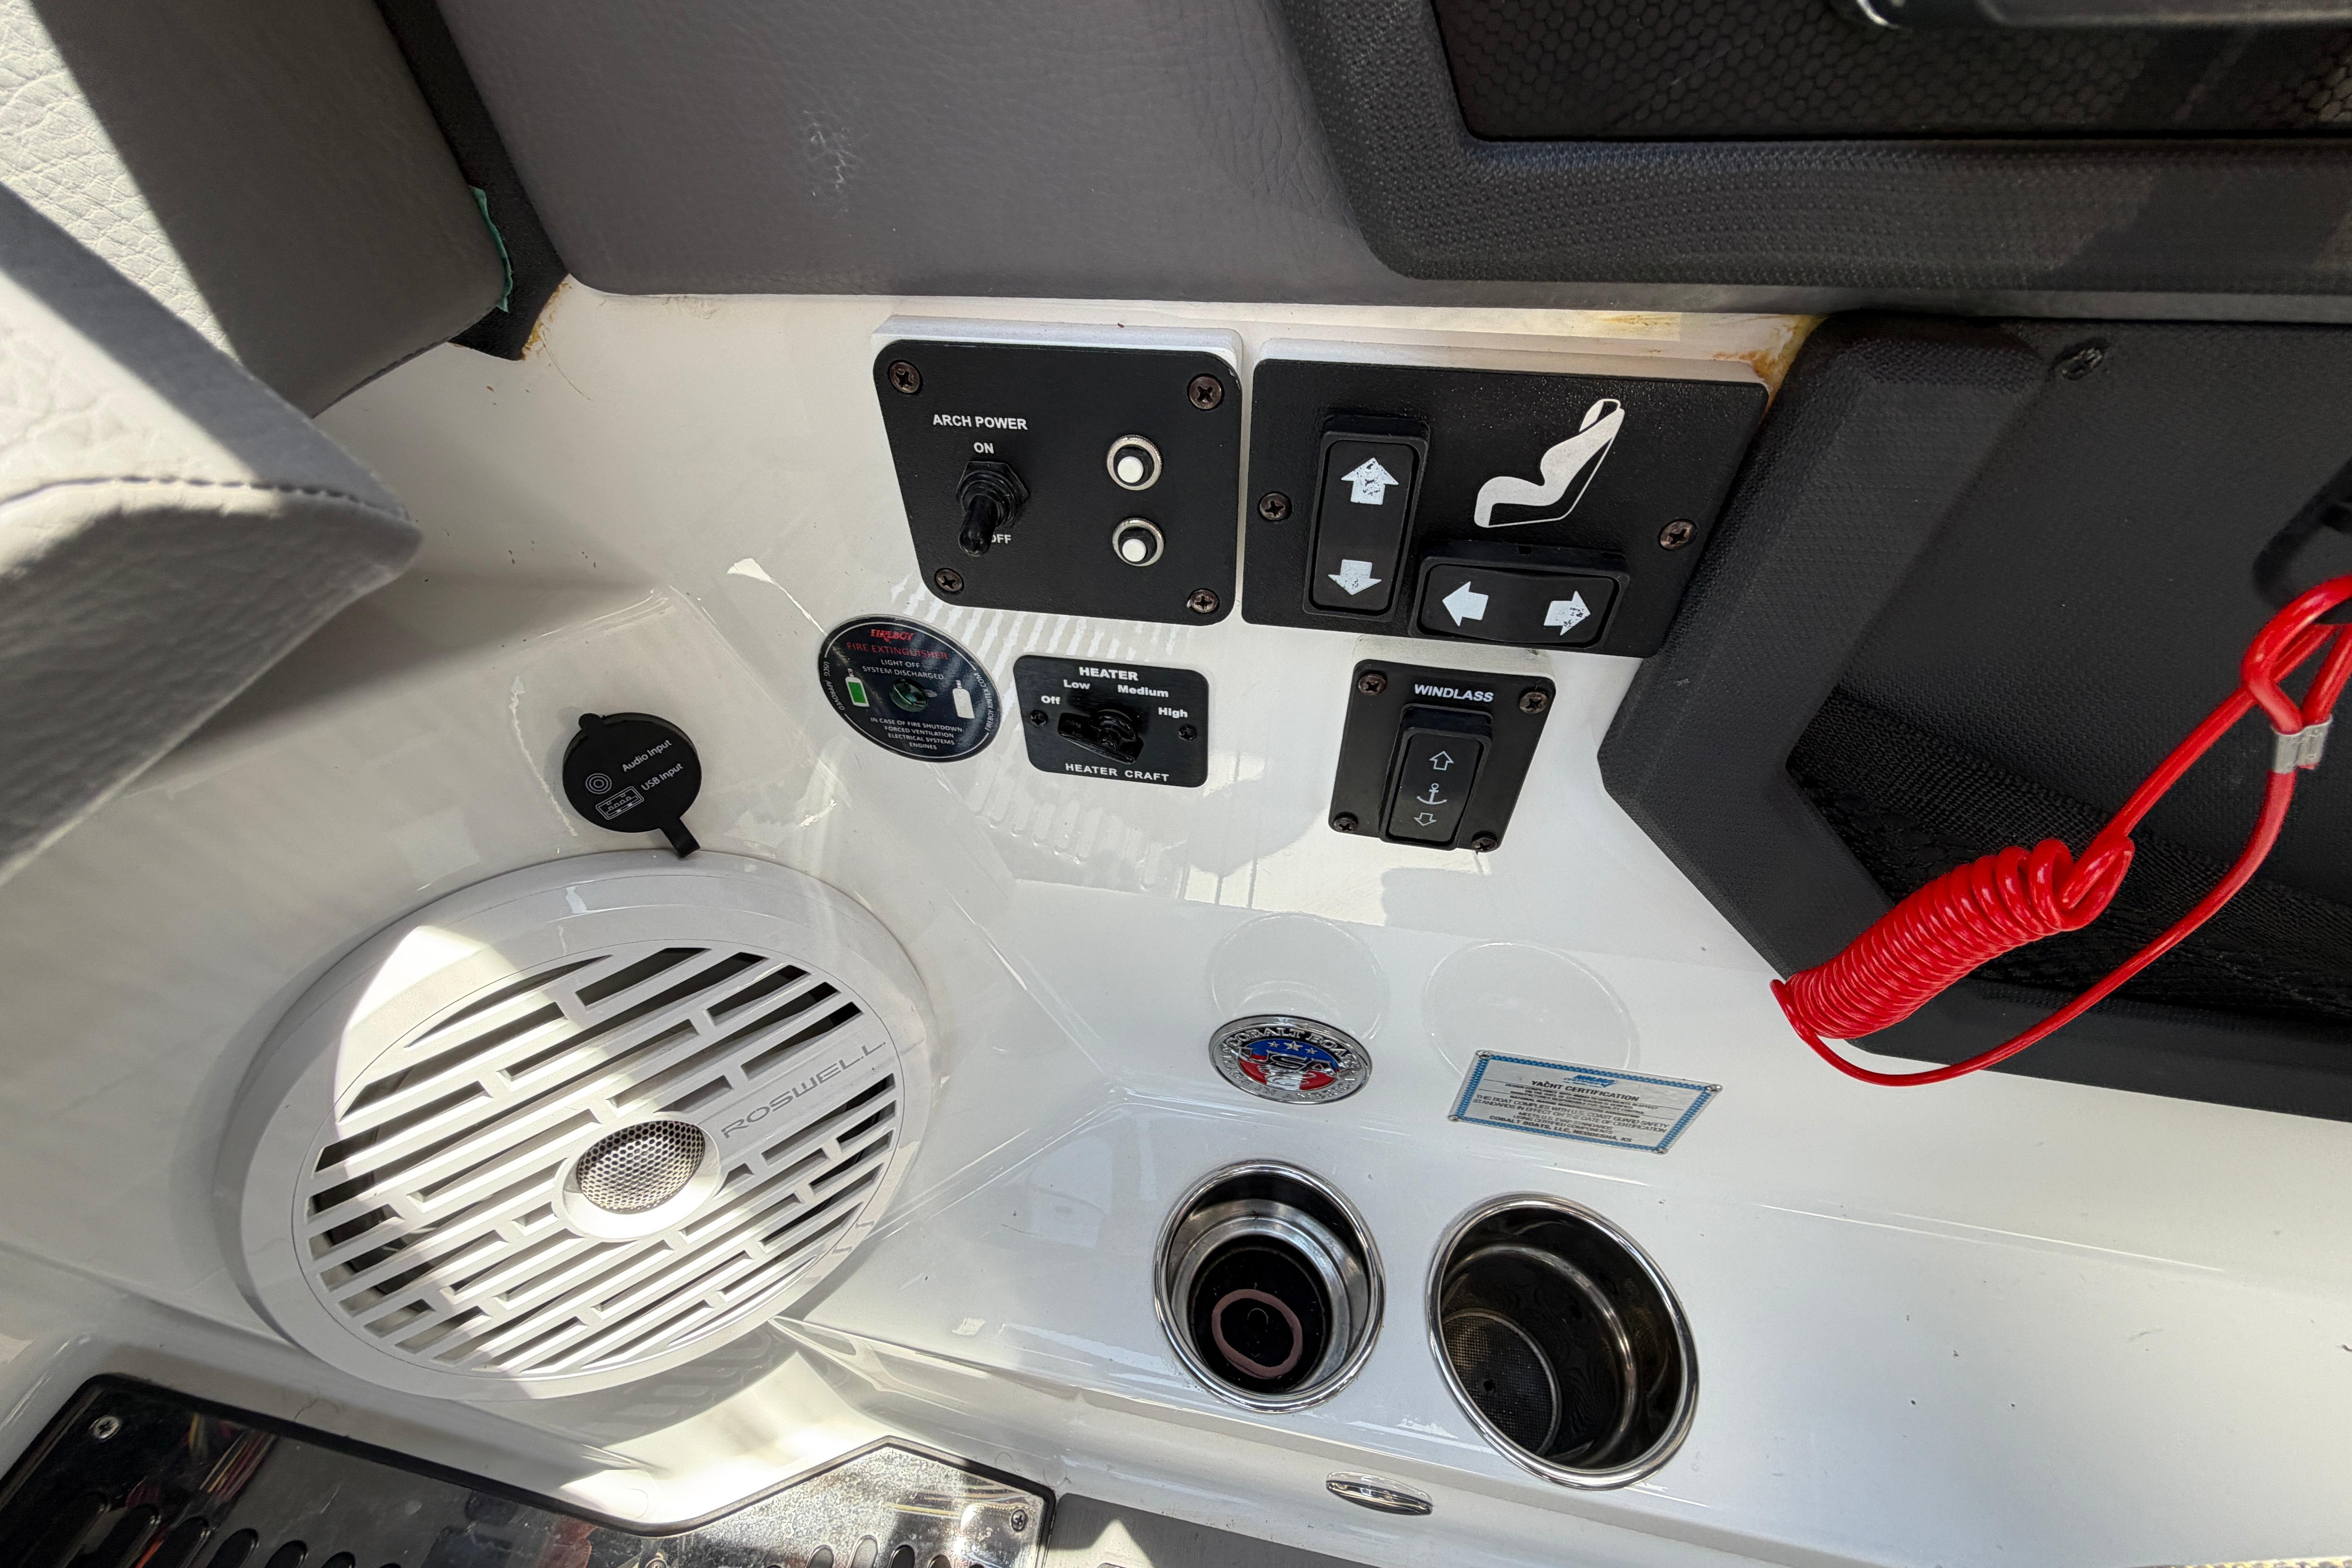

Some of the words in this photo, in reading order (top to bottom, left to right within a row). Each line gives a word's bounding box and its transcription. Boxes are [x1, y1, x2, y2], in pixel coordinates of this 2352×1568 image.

[933, 414, 972, 427] ARCH
[975, 416, 1028, 430] POWER
[973, 442, 994, 454] ON
[870, 629, 916, 644] FIREBOY
[847, 642, 869, 652] FIRE
[871, 644, 948, 660] EXTINGUISHER
[862, 665, 893, 674] SYSTEM
[894, 669, 944, 680] DISCHARGED
[1079, 667, 1139, 681] HEATER
[1063, 679, 1090, 690] Low
[1118, 684, 1169, 698] Medium
[824, 679, 845, 710] APPROVED
[1041, 695, 1061, 705] Off
[1414, 684, 1494, 702] WINDLASS
[1158, 707, 1188, 718] High
[911, 728, 954, 738] VENTILATION
[922, 723, 965, 733] SHUTDOWN:
[888, 733, 925, 742] ELECTRICAL
[925, 737, 955, 745] SYSTEMS
[909, 742, 938, 750] ENGINES
[622, 754, 649, 772] Audio
[646, 740, 672, 756] Input
[641, 777, 660, 790] USB
[659, 763, 684, 780] Input
[1065, 763, 1118, 777] HEATER
[1125, 770, 1169, 782] CRAFT
[1226, 1028, 1305, 1048] COBALT
[1305, 1033, 1360, 1069] BOATS
[1237, 1046, 1338, 1075] USA
[721, 1042, 886, 1139] ROSWELL
[1532, 1080, 1563, 1090] YACHT
[1565, 1085, 1639, 1101] CERTIFICATION
[1513, 1100, 1550, 1110] COMPLIES
[1472, 1098, 1516, 1109] STANDARDS
[1612, 1121, 1667, 1133] CERTIFICATION
[1489, 1115, 1521, 1124] COBALT
